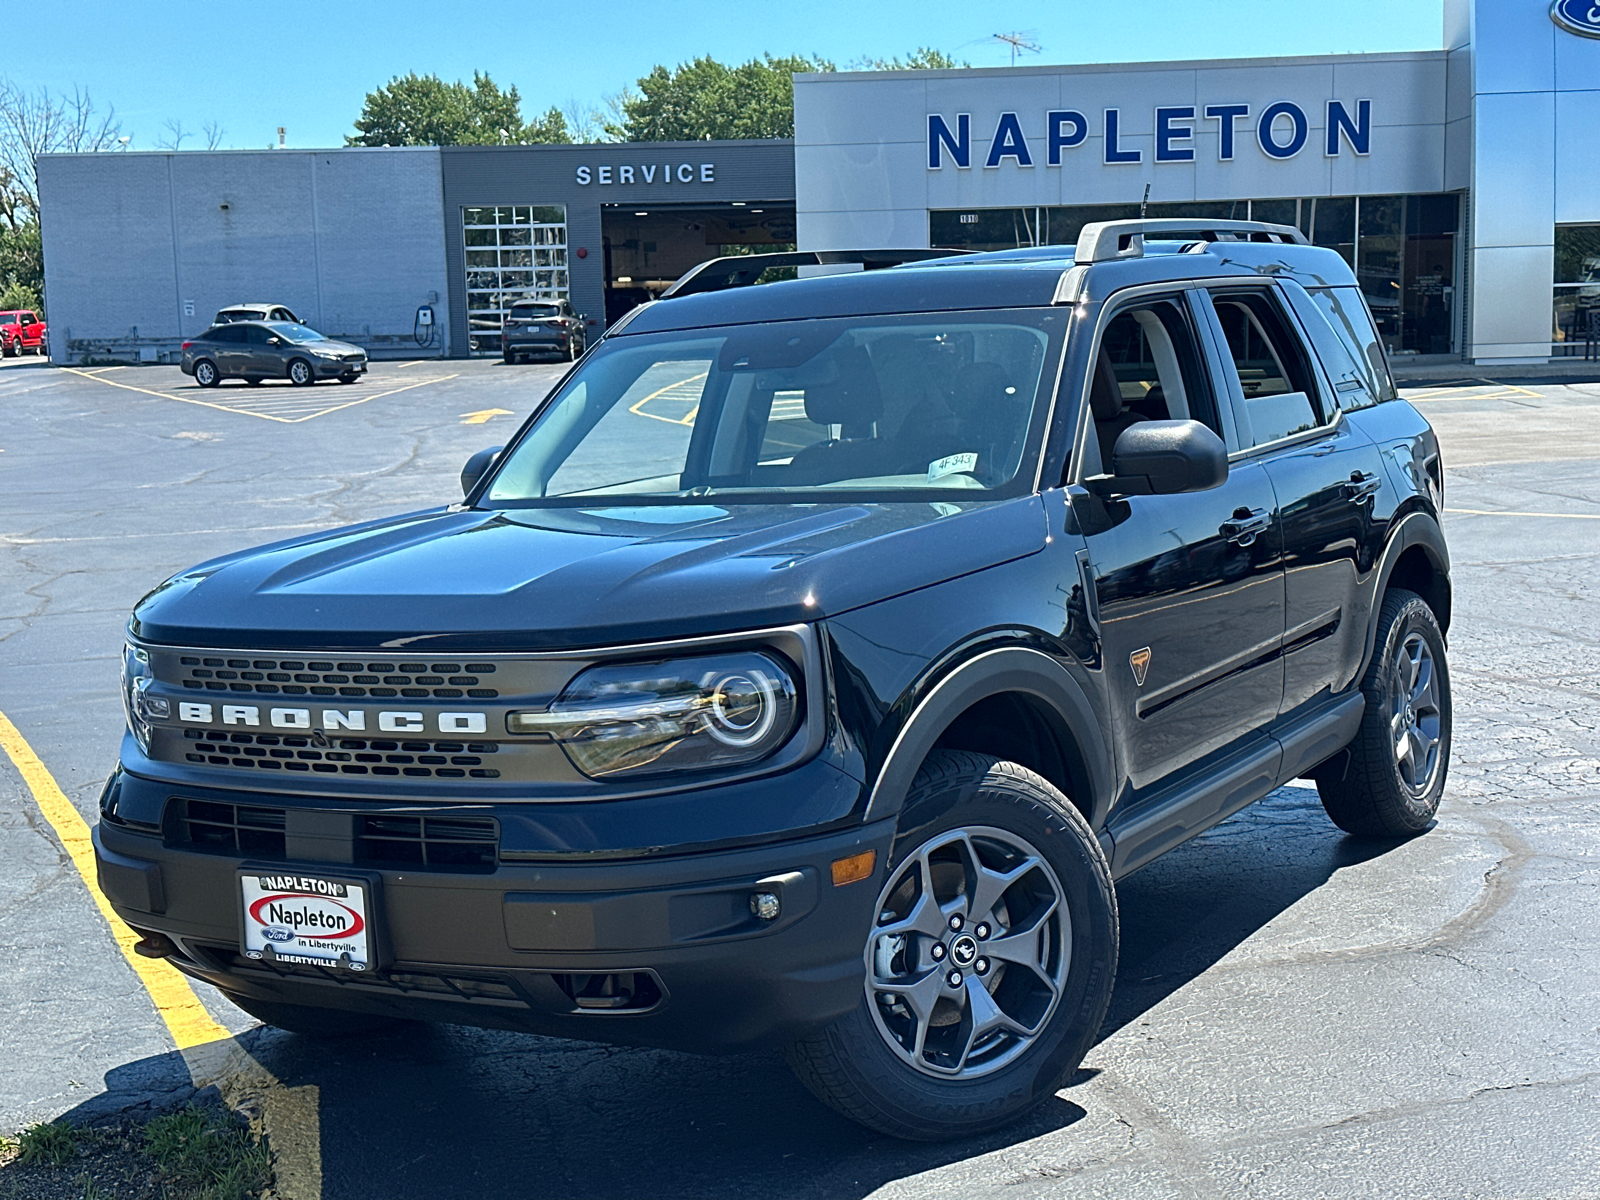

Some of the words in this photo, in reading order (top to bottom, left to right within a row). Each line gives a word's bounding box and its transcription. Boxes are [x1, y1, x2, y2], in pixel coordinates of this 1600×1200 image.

[926, 98, 1372, 170] NAPLETON
[576, 163, 714, 185] SERVICE
[939, 457, 950, 470] 4F
[951, 454, 972, 466] 343
[179, 701, 487, 734] BRONCO
[265, 876, 338, 896] NAPLETON
[269, 902, 346, 930] Napleton
[268, 927, 288, 940] Ford
[298, 937, 307, 947] in
[309, 939, 357, 953] Libertyville
[275, 953, 337, 968] LIBERTYVILLE
